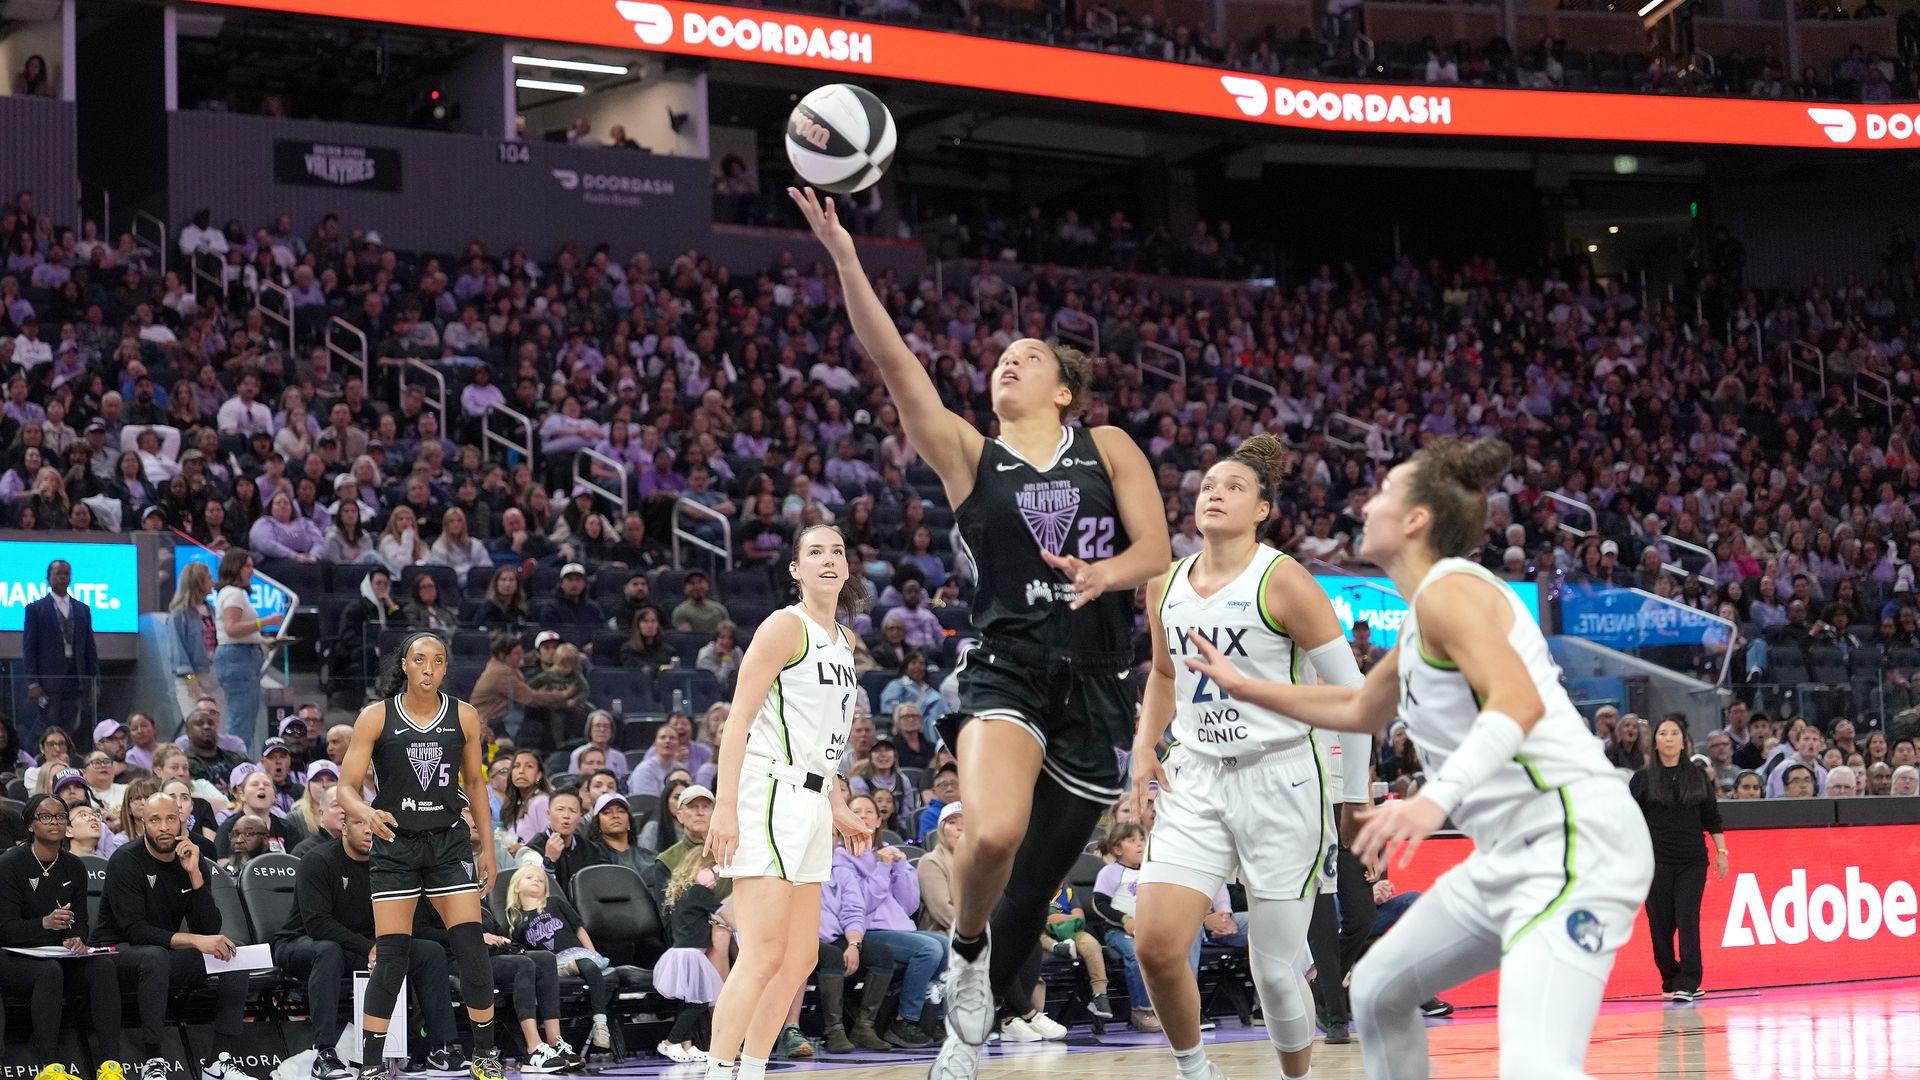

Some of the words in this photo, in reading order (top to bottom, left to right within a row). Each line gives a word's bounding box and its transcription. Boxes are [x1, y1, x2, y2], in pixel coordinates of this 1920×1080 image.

[683, 12, 872, 64] DOORDASH
[1275, 87, 1451, 124] DOORDASH
[500, 145, 529, 162] 104
[582, 174, 674, 195] DOORDASH
[1015, 487, 1081, 512] VALKYRIES
[1077, 517, 1115, 559] 22
[406, 746, 443, 760] VALKYRIES
[438, 763, 451, 787] 5
[1721, 866, 1918, 948] Adobe
